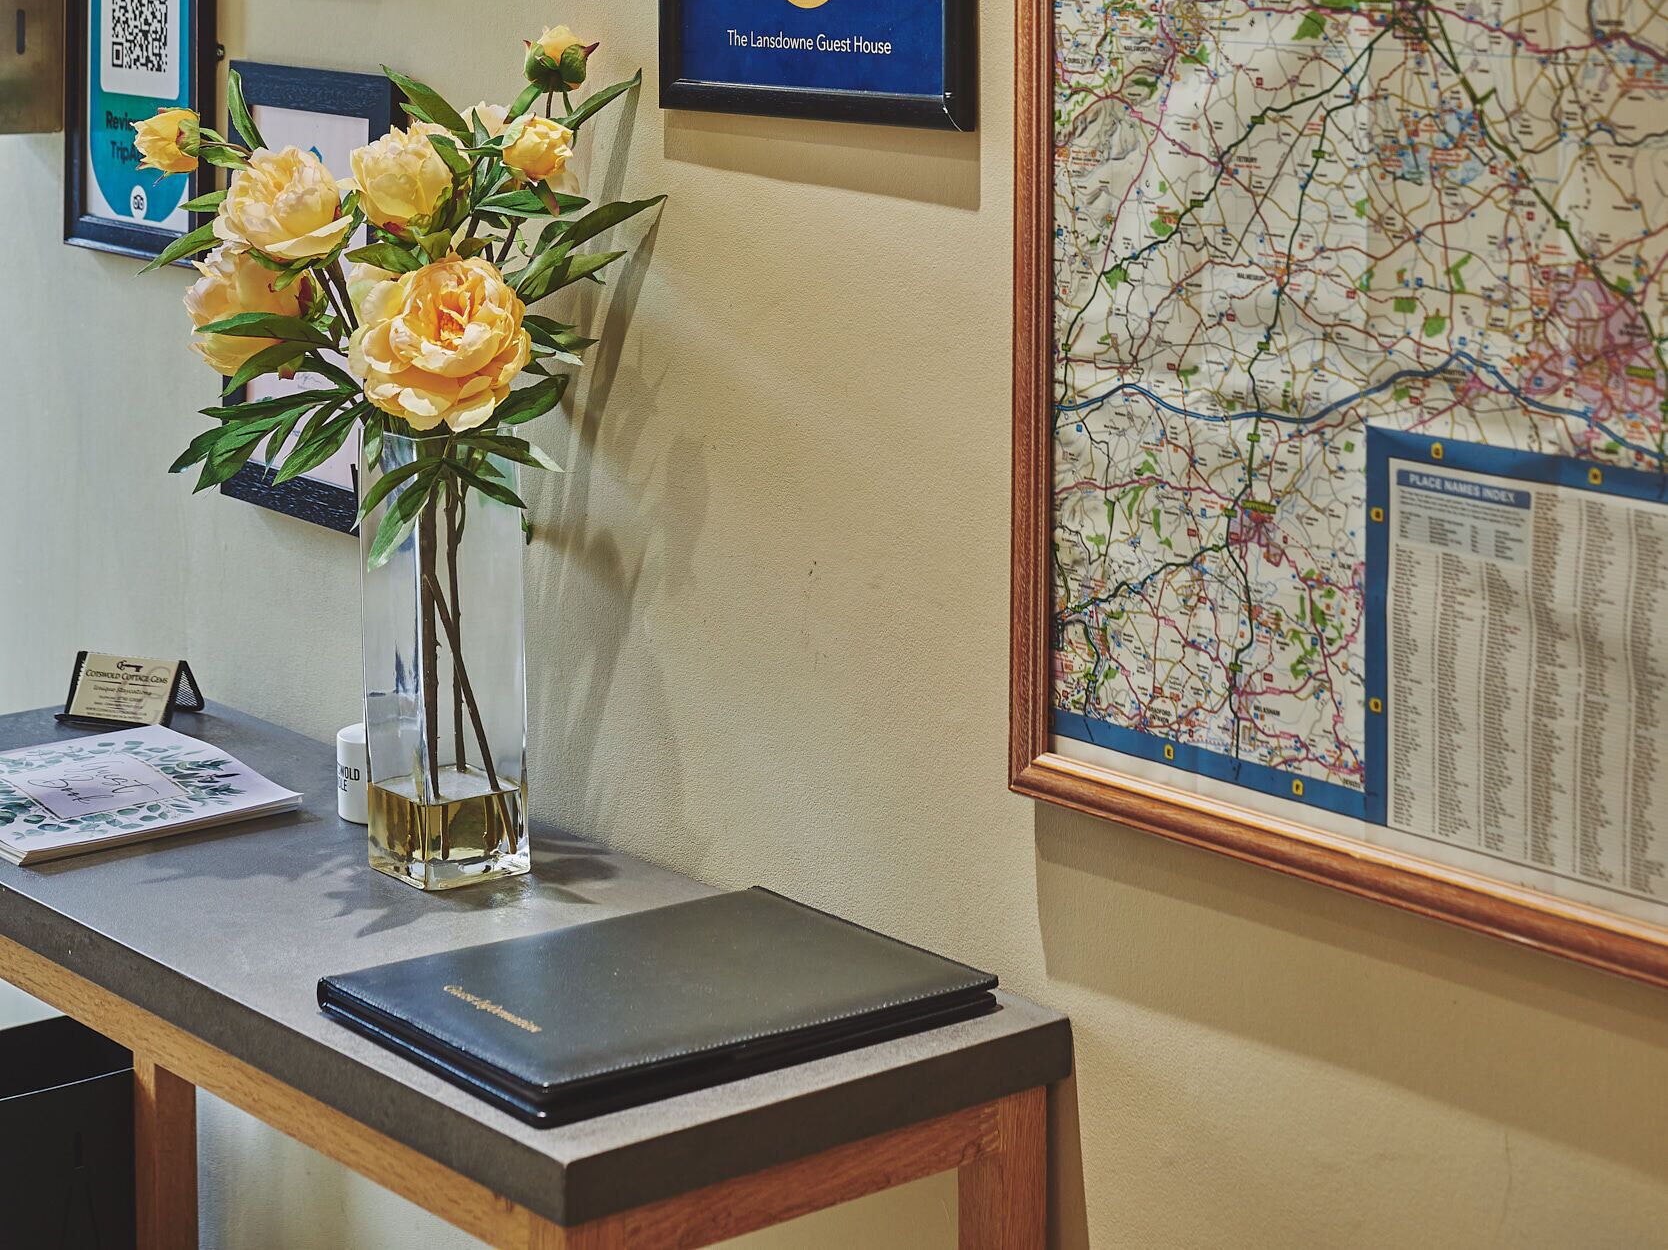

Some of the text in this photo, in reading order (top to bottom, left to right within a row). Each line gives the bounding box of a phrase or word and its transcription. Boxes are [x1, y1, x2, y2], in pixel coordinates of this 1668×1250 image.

[727, 29, 892, 55] The Lansdowne Guest House
[1408, 473, 1517, 503] PLACE NAMES INDEX
